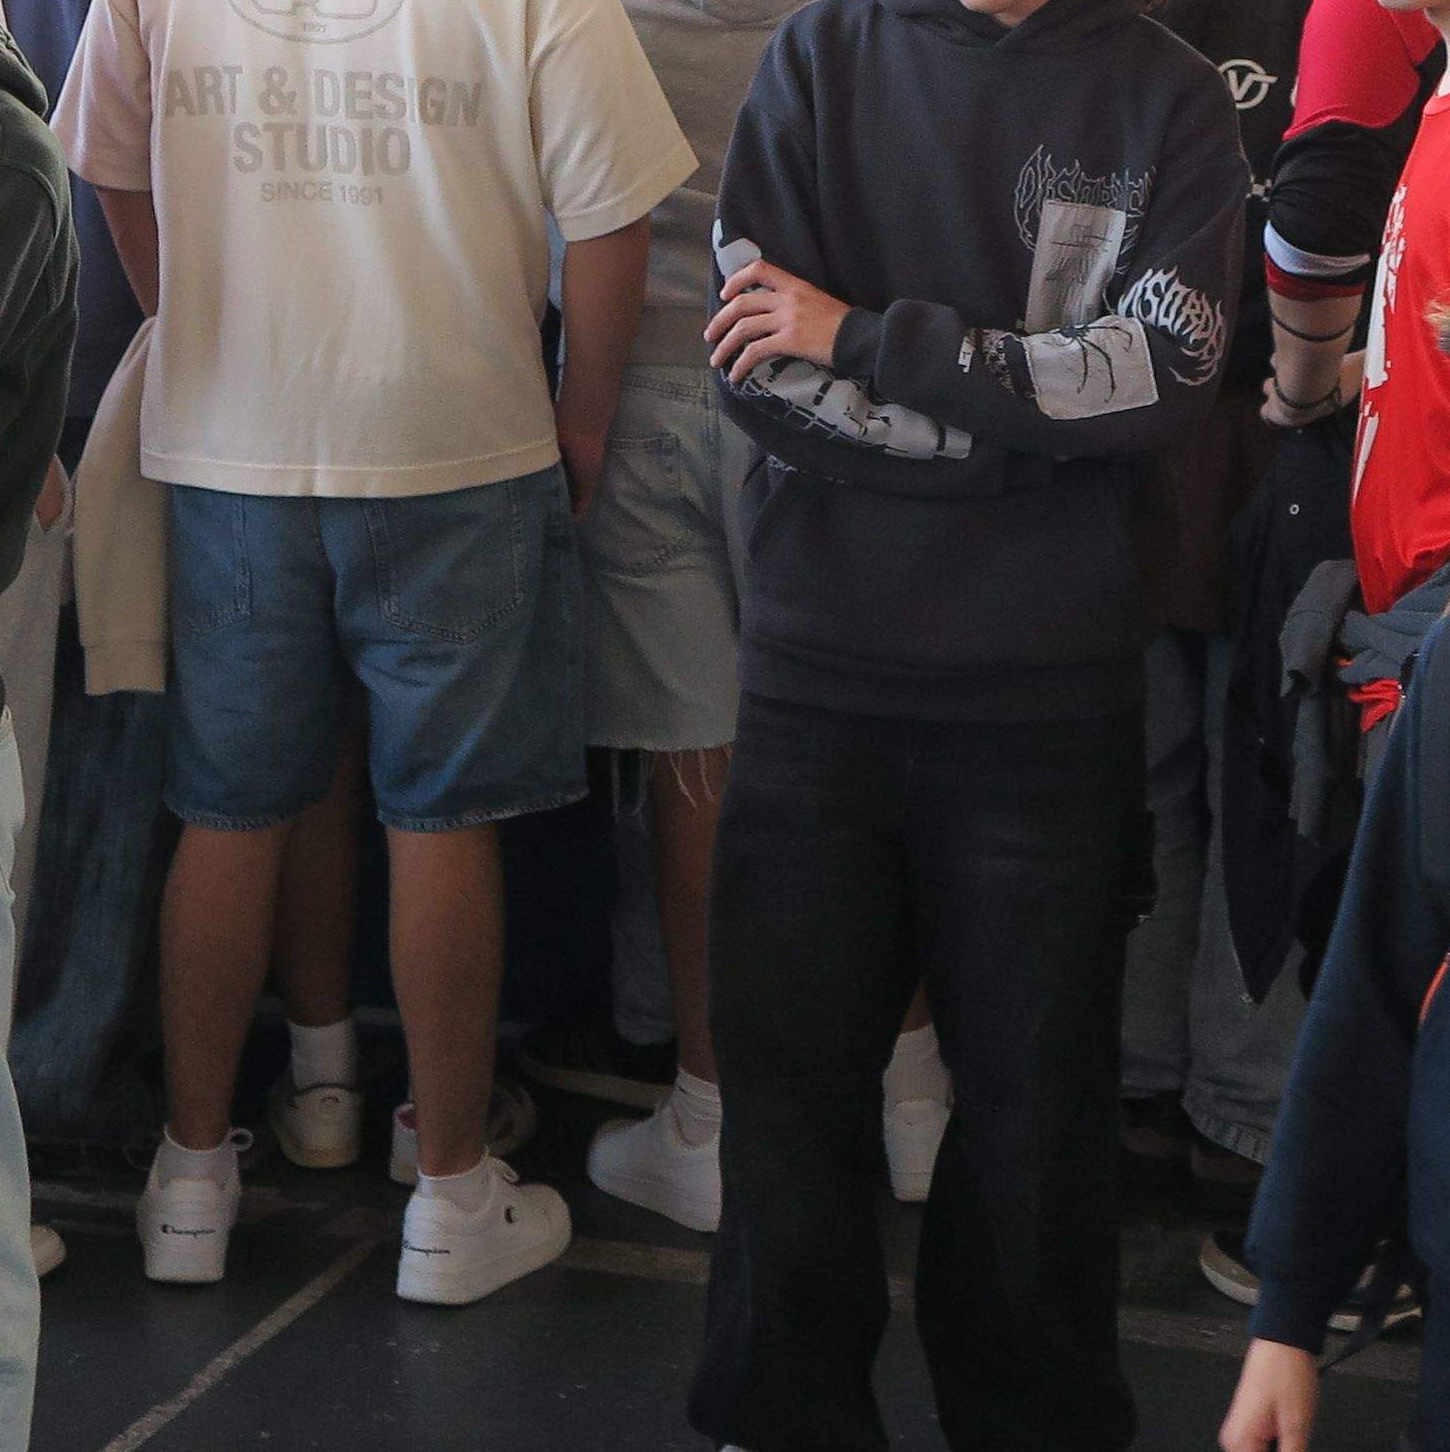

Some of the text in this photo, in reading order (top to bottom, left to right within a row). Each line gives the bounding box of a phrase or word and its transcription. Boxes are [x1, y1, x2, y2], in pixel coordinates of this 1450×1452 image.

[163, 65, 483, 127] ART & DESIGN
[232, 121, 411, 177] STUDIO
[260, 179, 334, 203] SINCE
